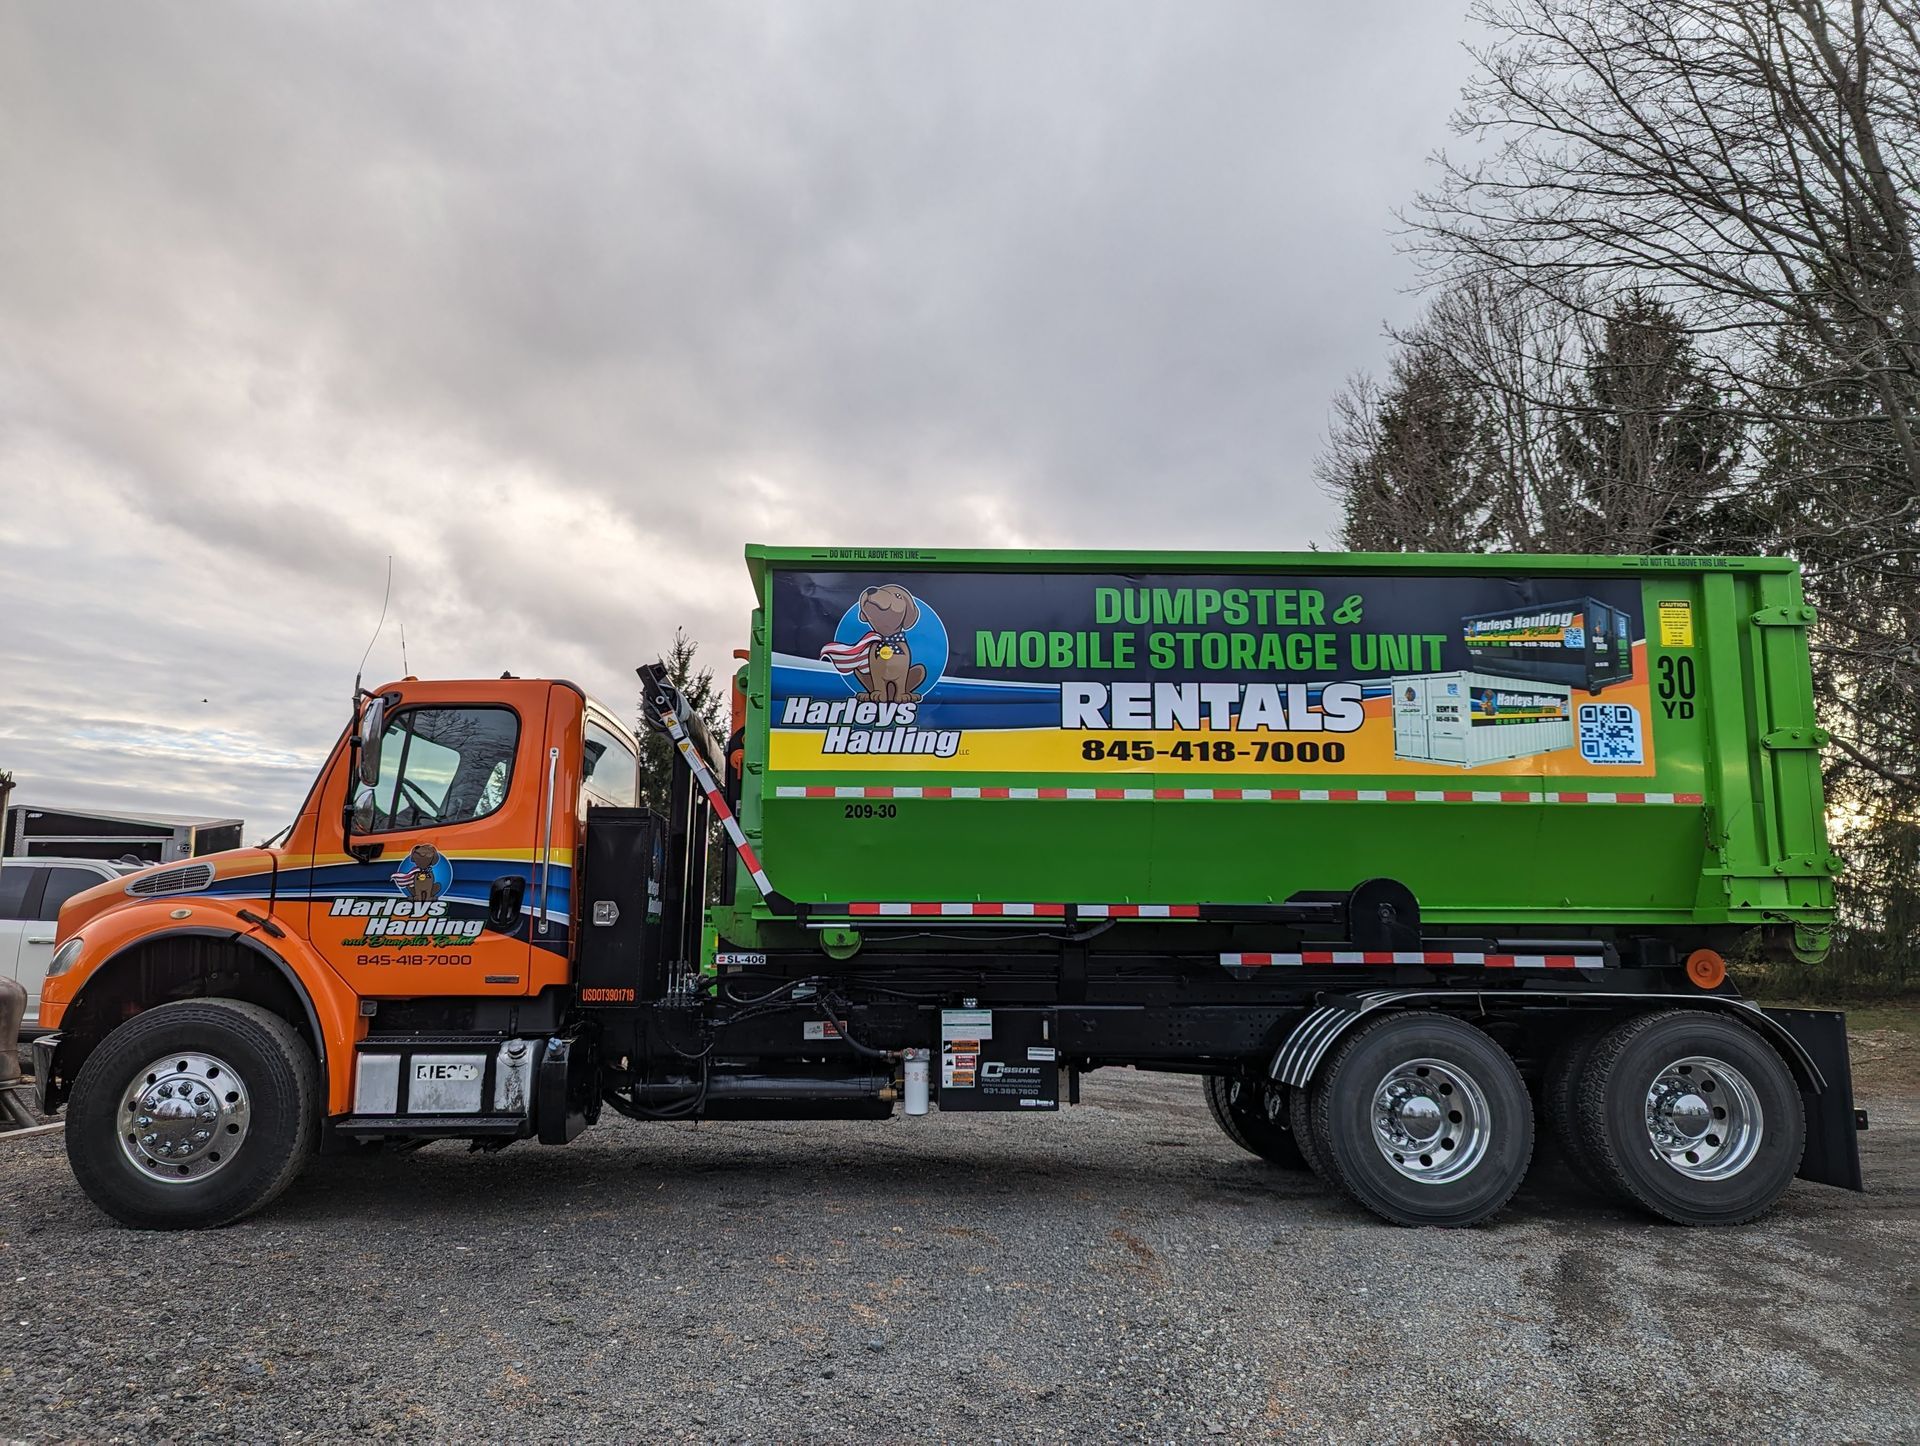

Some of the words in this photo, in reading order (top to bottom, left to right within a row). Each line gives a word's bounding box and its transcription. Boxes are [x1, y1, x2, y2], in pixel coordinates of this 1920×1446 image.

[829, 550, 838, 558] DO
[840, 550, 852, 558] NOT
[854, 551, 866, 559] FILL
[868, 551, 888, 559] ABOVE
[890, 551, 903, 559] THIS
[905, 551, 919, 560] LINE
[1095, 587, 1325, 626] DUMPSTER
[1333, 595, 1363, 624] &
[1477, 618, 1513, 632] Harleys
[1514, 612, 1574, 628] Hauling
[975, 630, 1135, 669] MOBILE
[1149, 632, 1337, 671] STORAGE
[1351, 634, 1447, 671] UNIT
[1657, 655, 1695, 700] 30
[1060, 682, 1364, 732] RENTALS
[1497, 693, 1533, 706] Harleys
[781, 697, 918, 727] Harleys
[1661, 701, 1694, 719] YD
[822, 726, 962, 758] Hauling
[1082, 740, 1345, 763] 845-418-7000
[844, 804, 897, 818] 209-30
[329, 898, 448, 918] Harleys
[364, 917, 485, 937] Hauling
[342, 936, 367, 946] and
[369, 935, 431, 950] Dumpster
[433, 936, 475, 948] Rental
[357, 955, 472, 966] 845-418-7000
[727, 955, 765, 964] SL-406
[582, 988, 635, 1001] USDOT3901719
